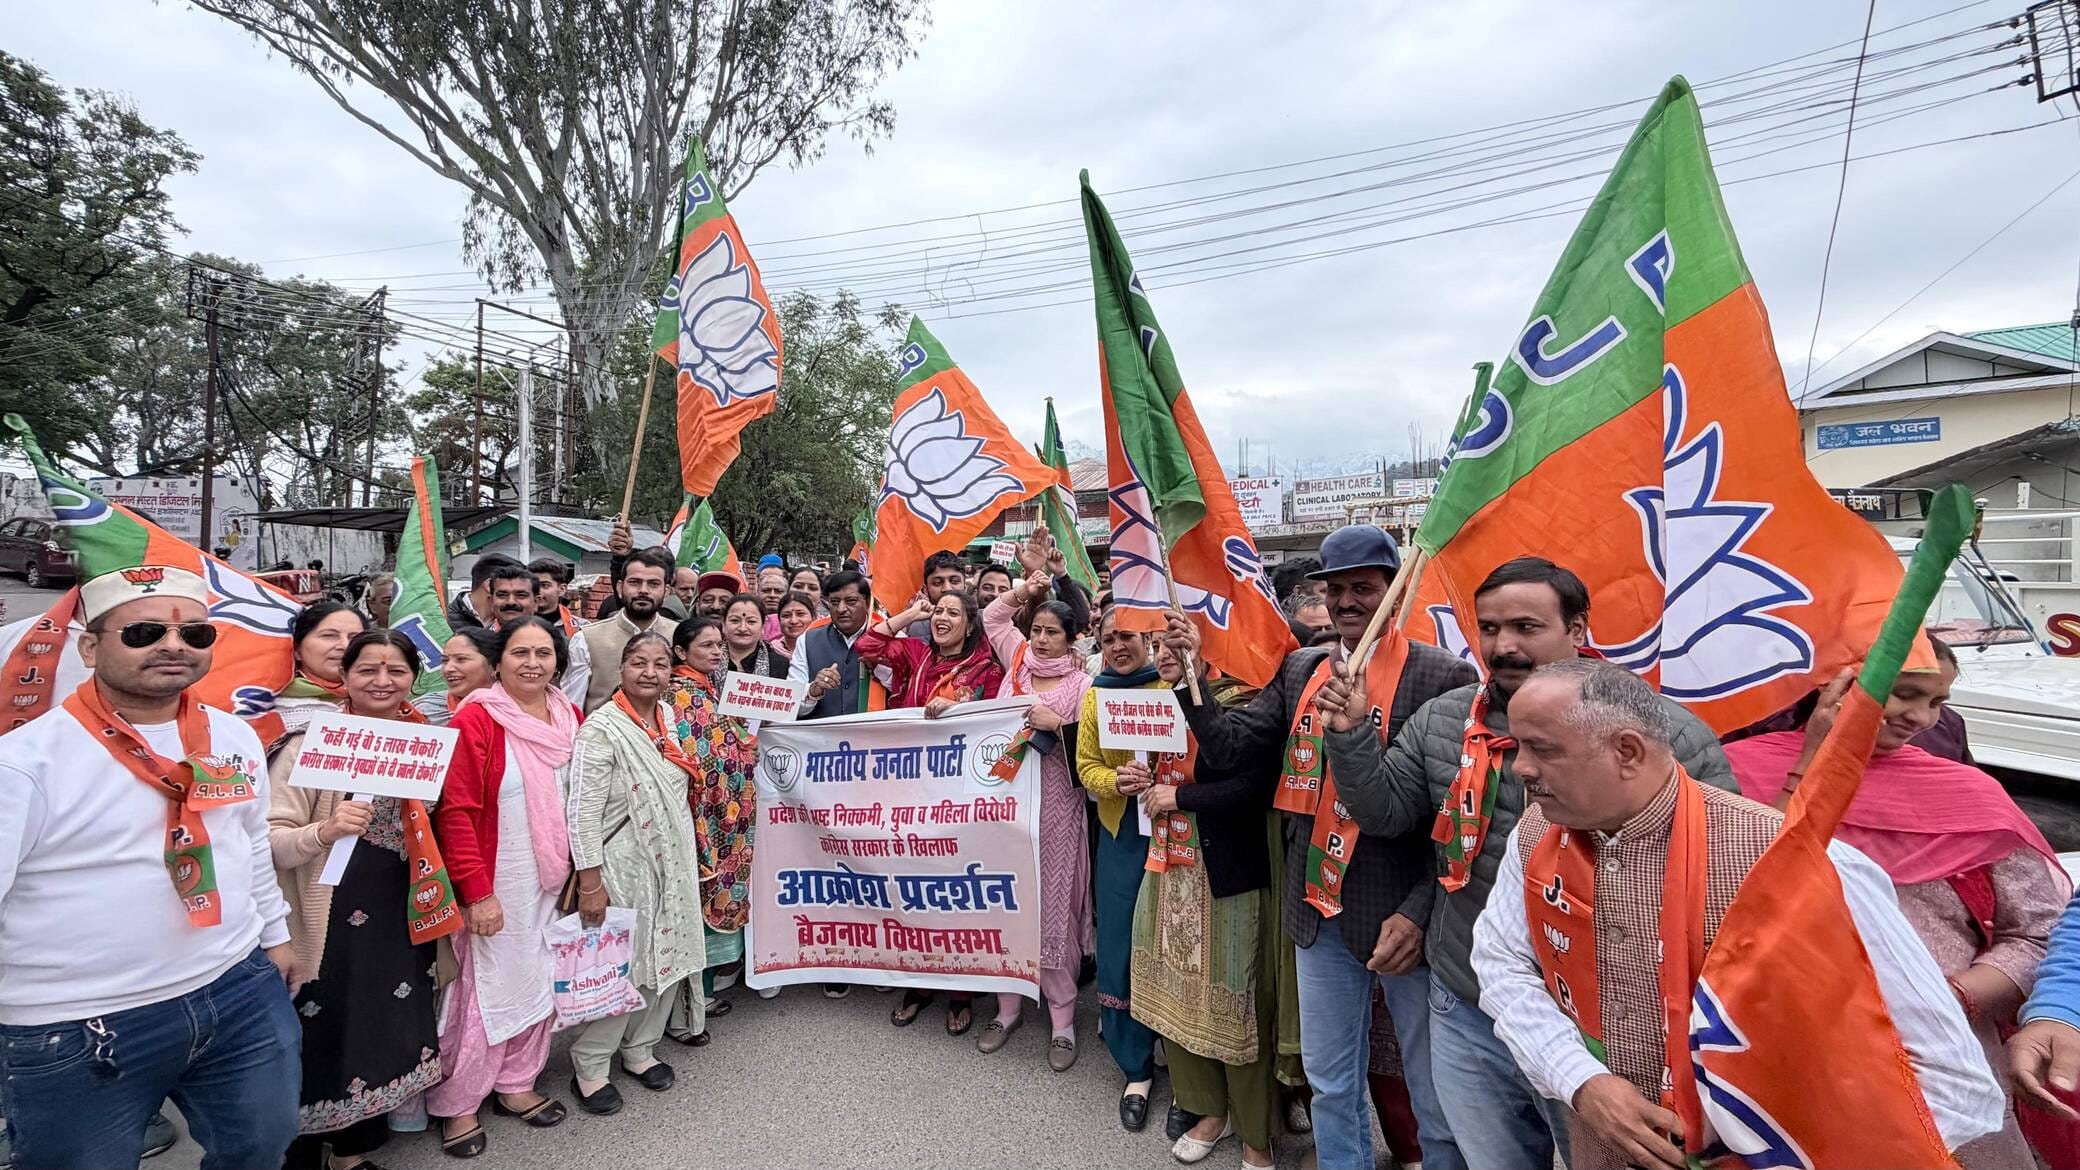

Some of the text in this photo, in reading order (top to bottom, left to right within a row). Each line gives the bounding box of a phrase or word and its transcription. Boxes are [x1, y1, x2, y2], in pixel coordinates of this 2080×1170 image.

[1855, 421, 1936, 437] जल भवन
[1311, 477, 1372, 492] HEALTH CARE
[1297, 496, 1330, 505] CLINICAL
[346, 728, 363, 751] गई
[362, 731, 375, 750] वो
[374, 736, 383, 751] 5
[383, 737, 409, 754] लाख
[409, 737, 443, 759] नौकरी?
[323, 754, 347, 772] सरकार
[347, 753, 355, 773] ने
[377, 757, 388, 776] को
[805, 734, 967, 782] भारतीय जनता पार्टी
[769, 801, 797, 826] प्रदेश
[890, 806, 915, 833] युवा
[918, 807, 928, 825] व
[930, 799, 969, 825] महिला
[974, 796, 1018, 824] विरोधी
[852, 838, 890, 858] सरकार
[893, 833, 905, 857] के
[907, 834, 959, 857] खिलाफ
[776, 862, 1019, 912] आक्रोश प्रदर्शन
[414, 905, 454, 931] B.J.P.
[793, 915, 1004, 955] बैजनाथ विधानसभा
[571, 967, 617, 992] Ashwani
